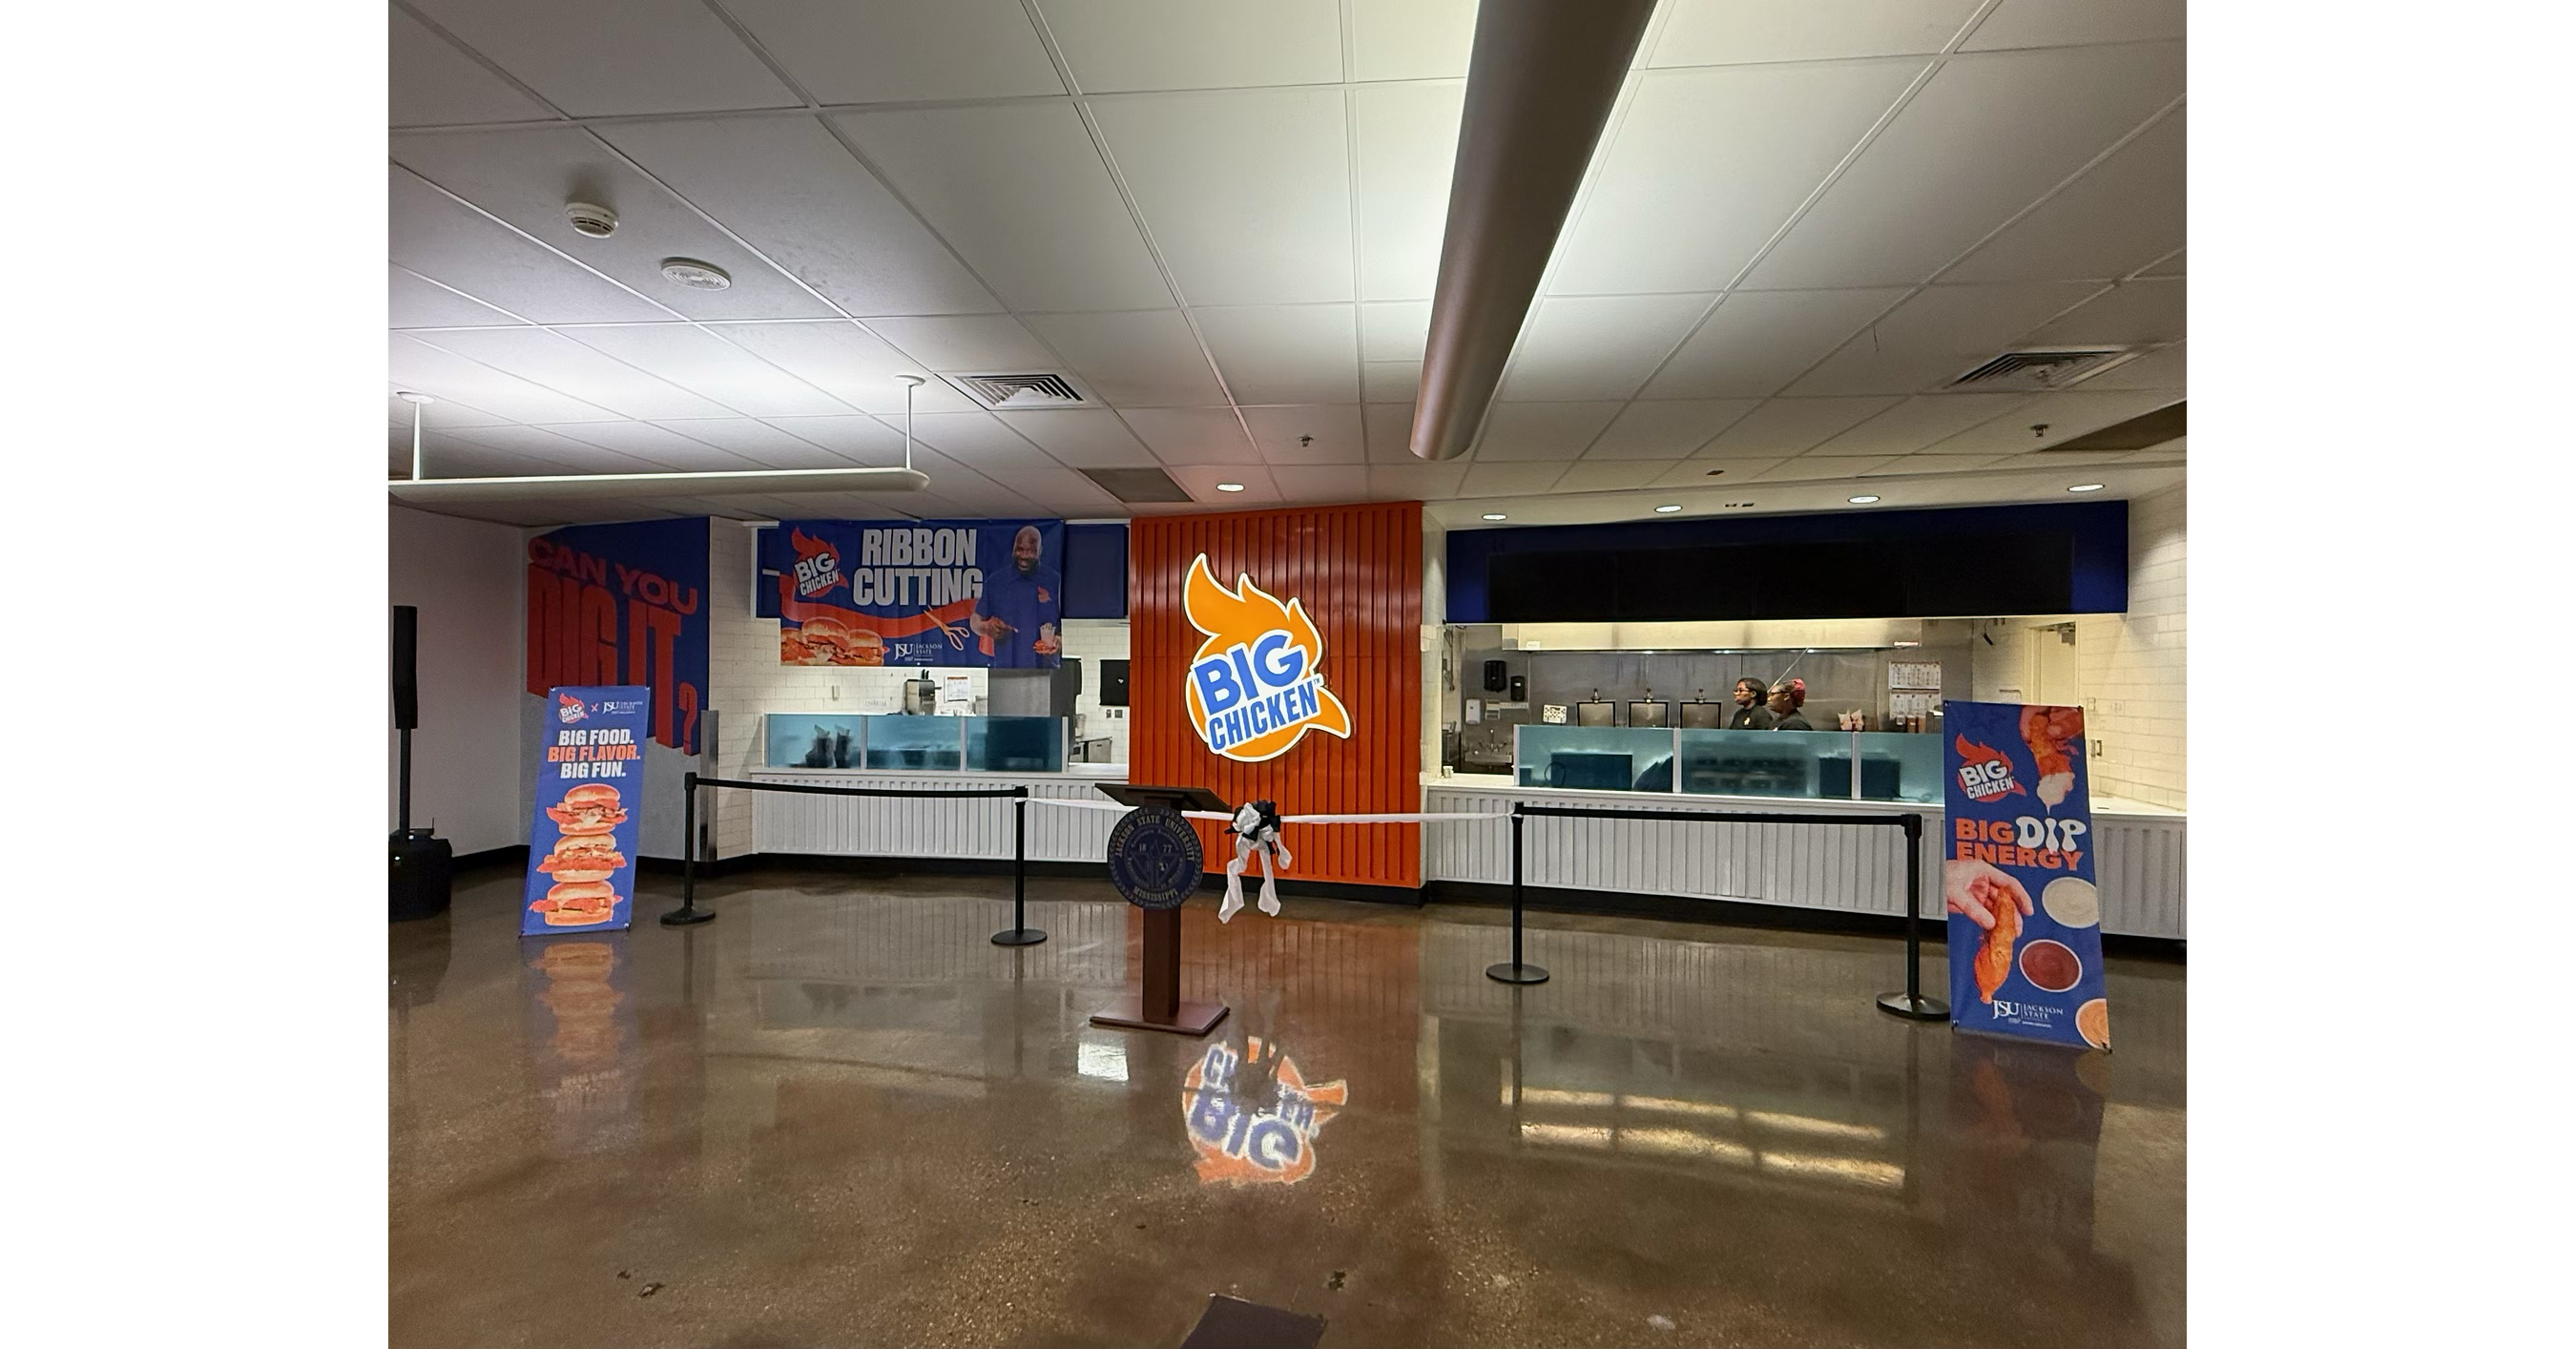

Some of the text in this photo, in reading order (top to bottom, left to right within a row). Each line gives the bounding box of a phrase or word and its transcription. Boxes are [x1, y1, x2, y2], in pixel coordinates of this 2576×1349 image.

[862, 529, 978, 566] RIBBON
[529, 536, 698, 615] CAN YOU
[794, 552, 835, 583] BIG
[800, 570, 840, 596] CHICKEN
[853, 568, 984, 606] CUTTING
[527, 562, 618, 699] DIG
[894, 643, 914, 661] JSU
[1194, 634, 1304, 716] BIG
[559, 704, 583, 717] BIG
[1208, 680, 1319, 751] CHICKEN
[558, 729, 634, 746] BIG FOOD.
[548, 745, 641, 762] BIG FLAVOR.
[560, 762, 627, 778] BIG FUN.
[1959, 760, 2007, 787] BIG
[1966, 778, 2015, 799] CHICKEN
[1136, 815, 1161, 824] STATE
[1165, 819, 1195, 861] UNIVERSITY
[1955, 816, 2087, 852] BIG DIP
[1956, 841, 2084, 871] ENERGY
[1132, 885, 1179, 903] MISSISSIPPI
[1992, 1000, 2064, 1019] JSU JACKSON
